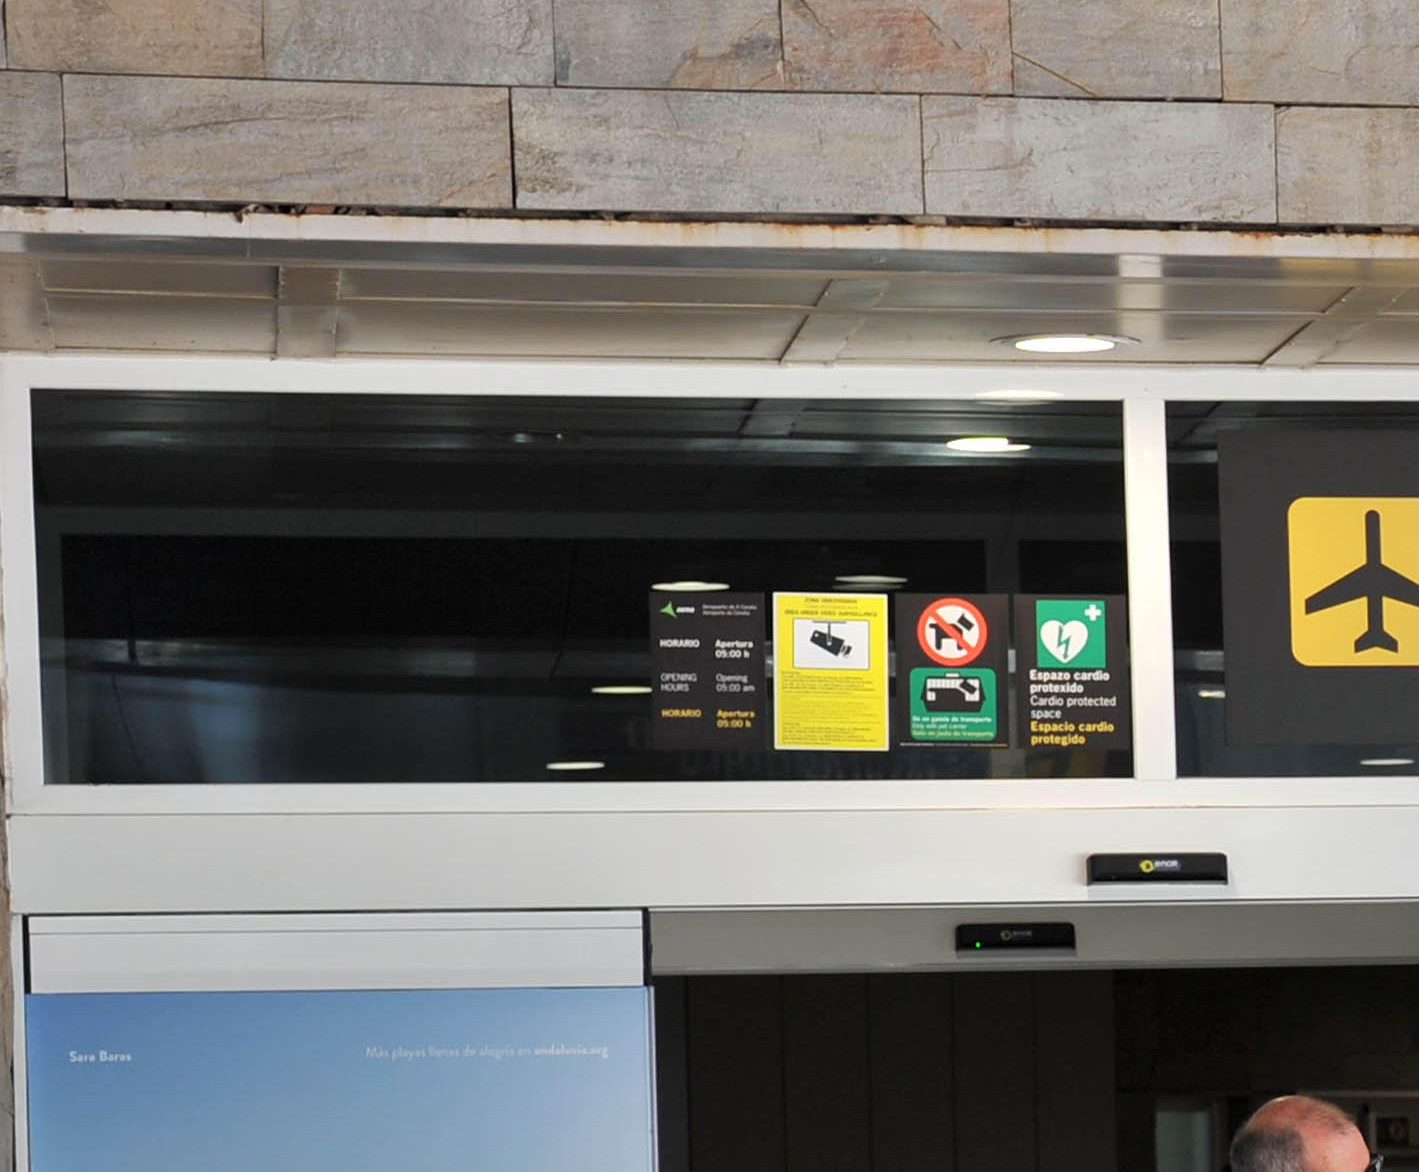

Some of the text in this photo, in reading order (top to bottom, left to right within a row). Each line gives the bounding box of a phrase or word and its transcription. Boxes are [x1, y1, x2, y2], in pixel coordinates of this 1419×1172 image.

[659, 639, 700, 648] HORARIO
[715, 639, 753, 650] Apertura
[715, 649, 750, 659] 05:00 h
[660, 673, 697, 682] OPENING
[716, 673, 748, 684] Opening
[1029, 669, 1110, 682] Espazo cardio
[661, 683, 690, 692] HOURS
[716, 683, 741, 692] 05:00
[1030, 682, 1084, 694] protexido
[1030, 695, 1117, 708] Cardio protected
[661, 708, 702, 718] HORARIO
[717, 709, 755, 720] Apertura
[1030, 709, 1062, 719] space
[717, 719, 752, 728] 05:00 h
[1031, 721, 1115, 733] Espacio cardio
[1031, 734, 1086, 746] protegido
[69, 1049, 133, 1062] Sara Baras
